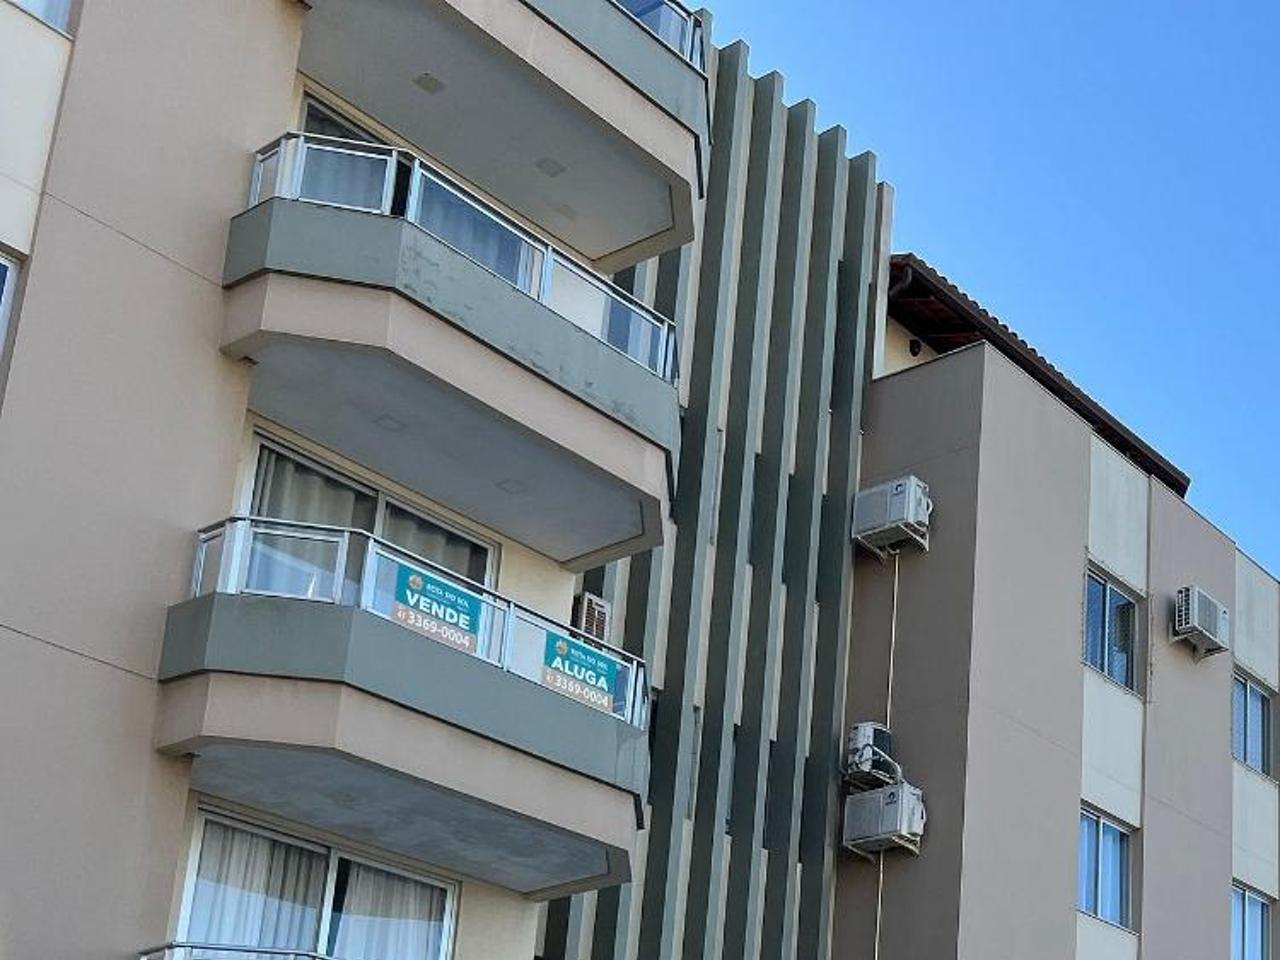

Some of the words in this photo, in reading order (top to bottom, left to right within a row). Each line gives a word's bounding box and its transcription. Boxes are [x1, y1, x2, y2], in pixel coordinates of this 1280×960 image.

[406, 589, 470, 630] VENDE
[407, 611, 470, 647] 3369-0004
[551, 656, 609, 692] ALUGA
[555, 675, 609, 707] 3369-0004
